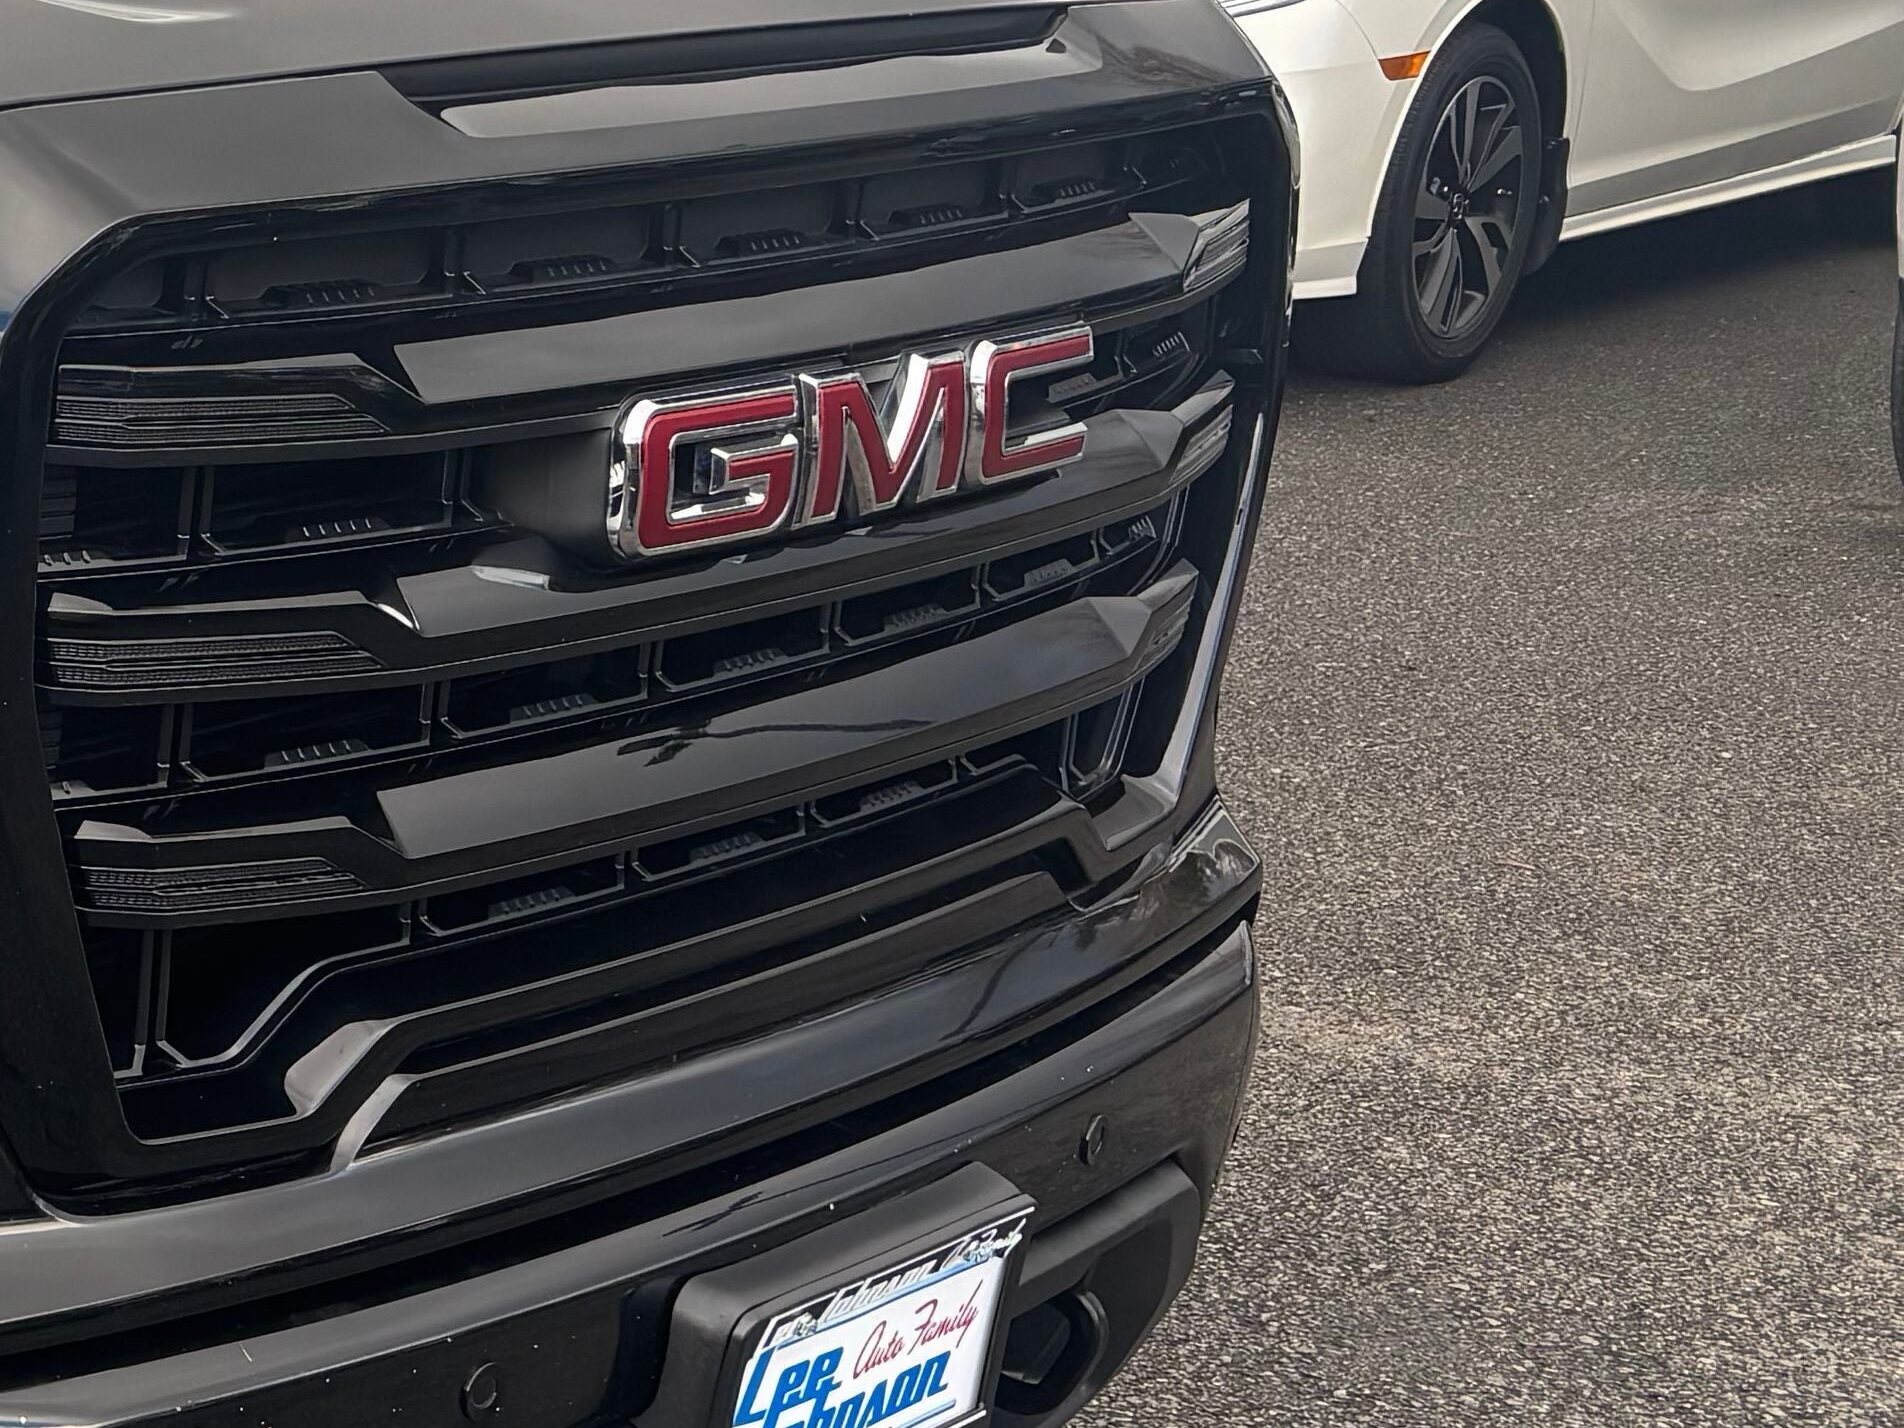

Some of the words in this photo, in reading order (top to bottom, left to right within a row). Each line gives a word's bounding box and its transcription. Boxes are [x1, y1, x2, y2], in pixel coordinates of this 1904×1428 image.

[608, 320, 1093, 557] GMC
[852, 1319, 906, 1380] Auto
[906, 1278, 984, 1357] Family
[732, 1345, 845, 1427] Lee
